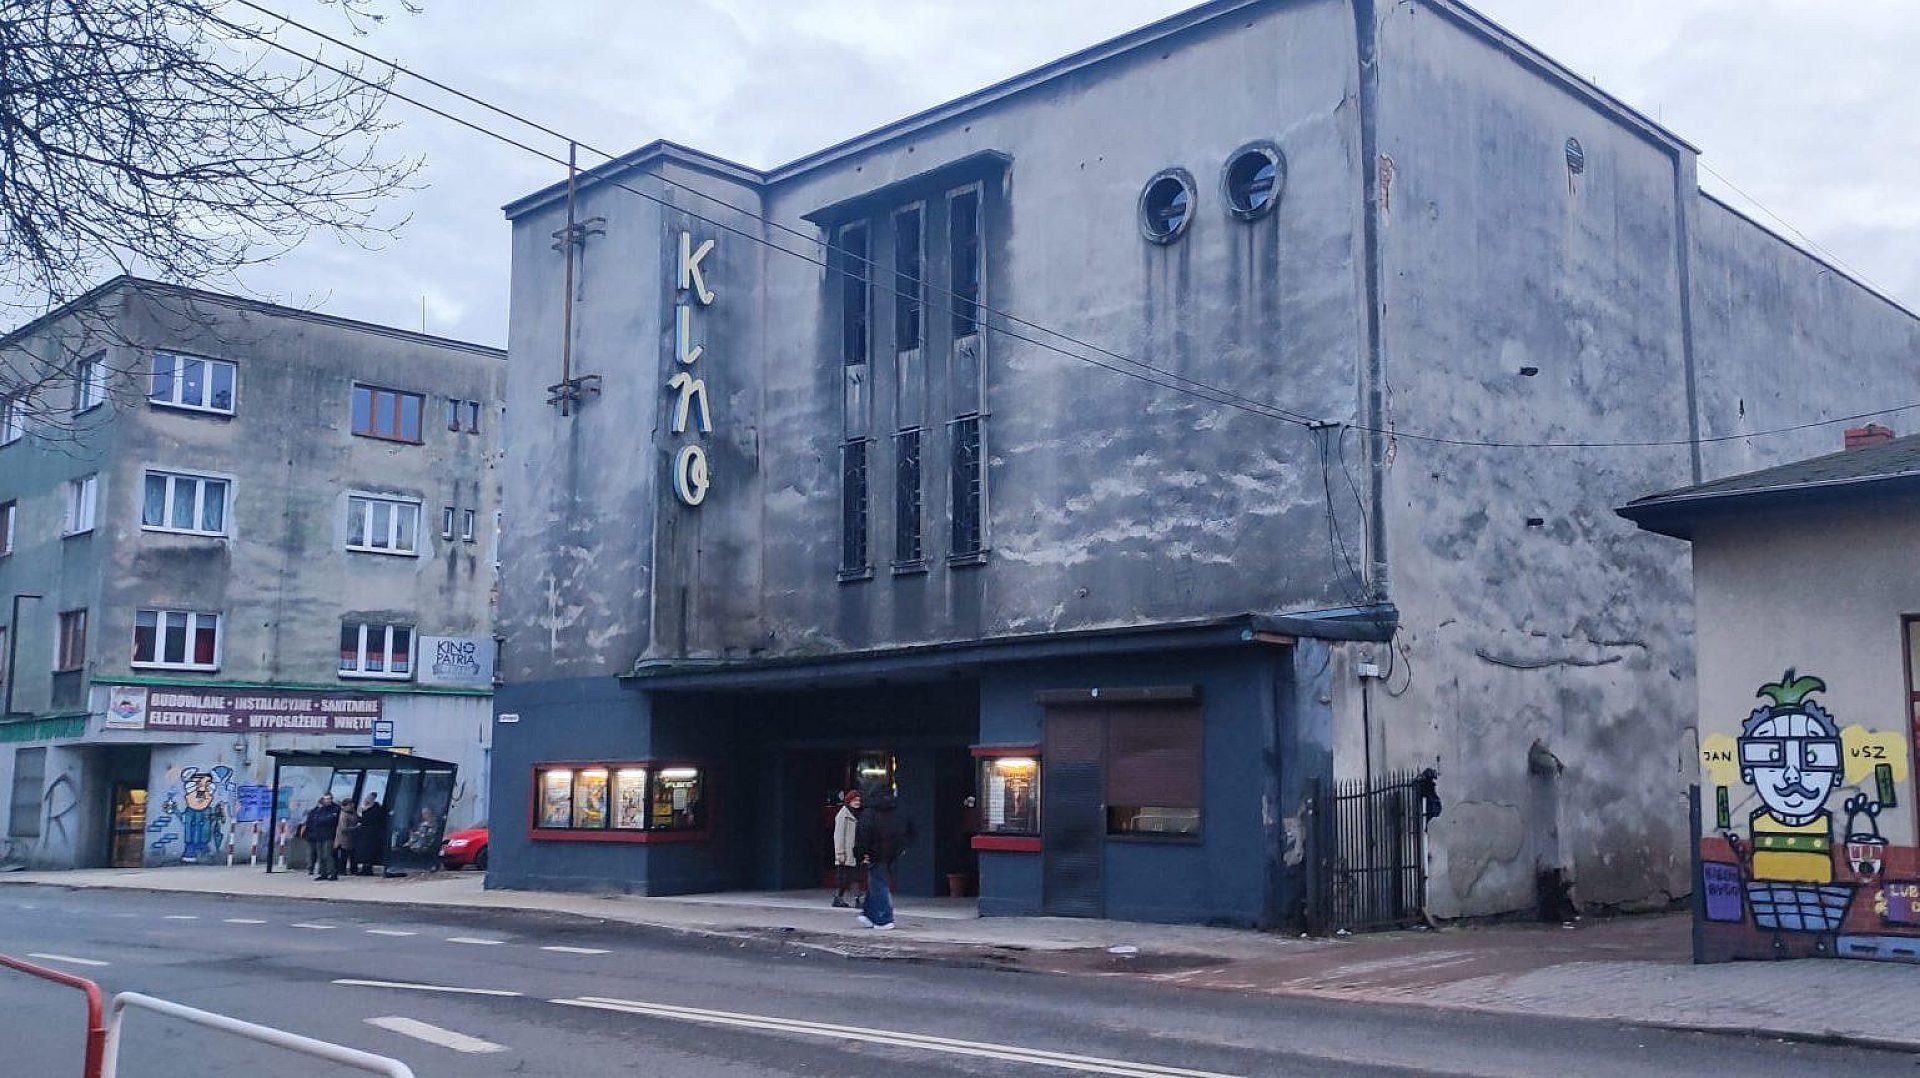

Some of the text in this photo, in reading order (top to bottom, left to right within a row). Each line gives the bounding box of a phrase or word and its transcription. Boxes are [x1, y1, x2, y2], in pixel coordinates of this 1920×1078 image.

[437, 640, 475, 654] KINO
[436, 653, 475, 664] PATRIA
[151, 692, 378, 712] BUDOWLANE INSTALACYJNE SANITARNE
[149, 711, 231, 727] ELEKTRYCZNE
[1703, 751, 1732, 762] JAN
